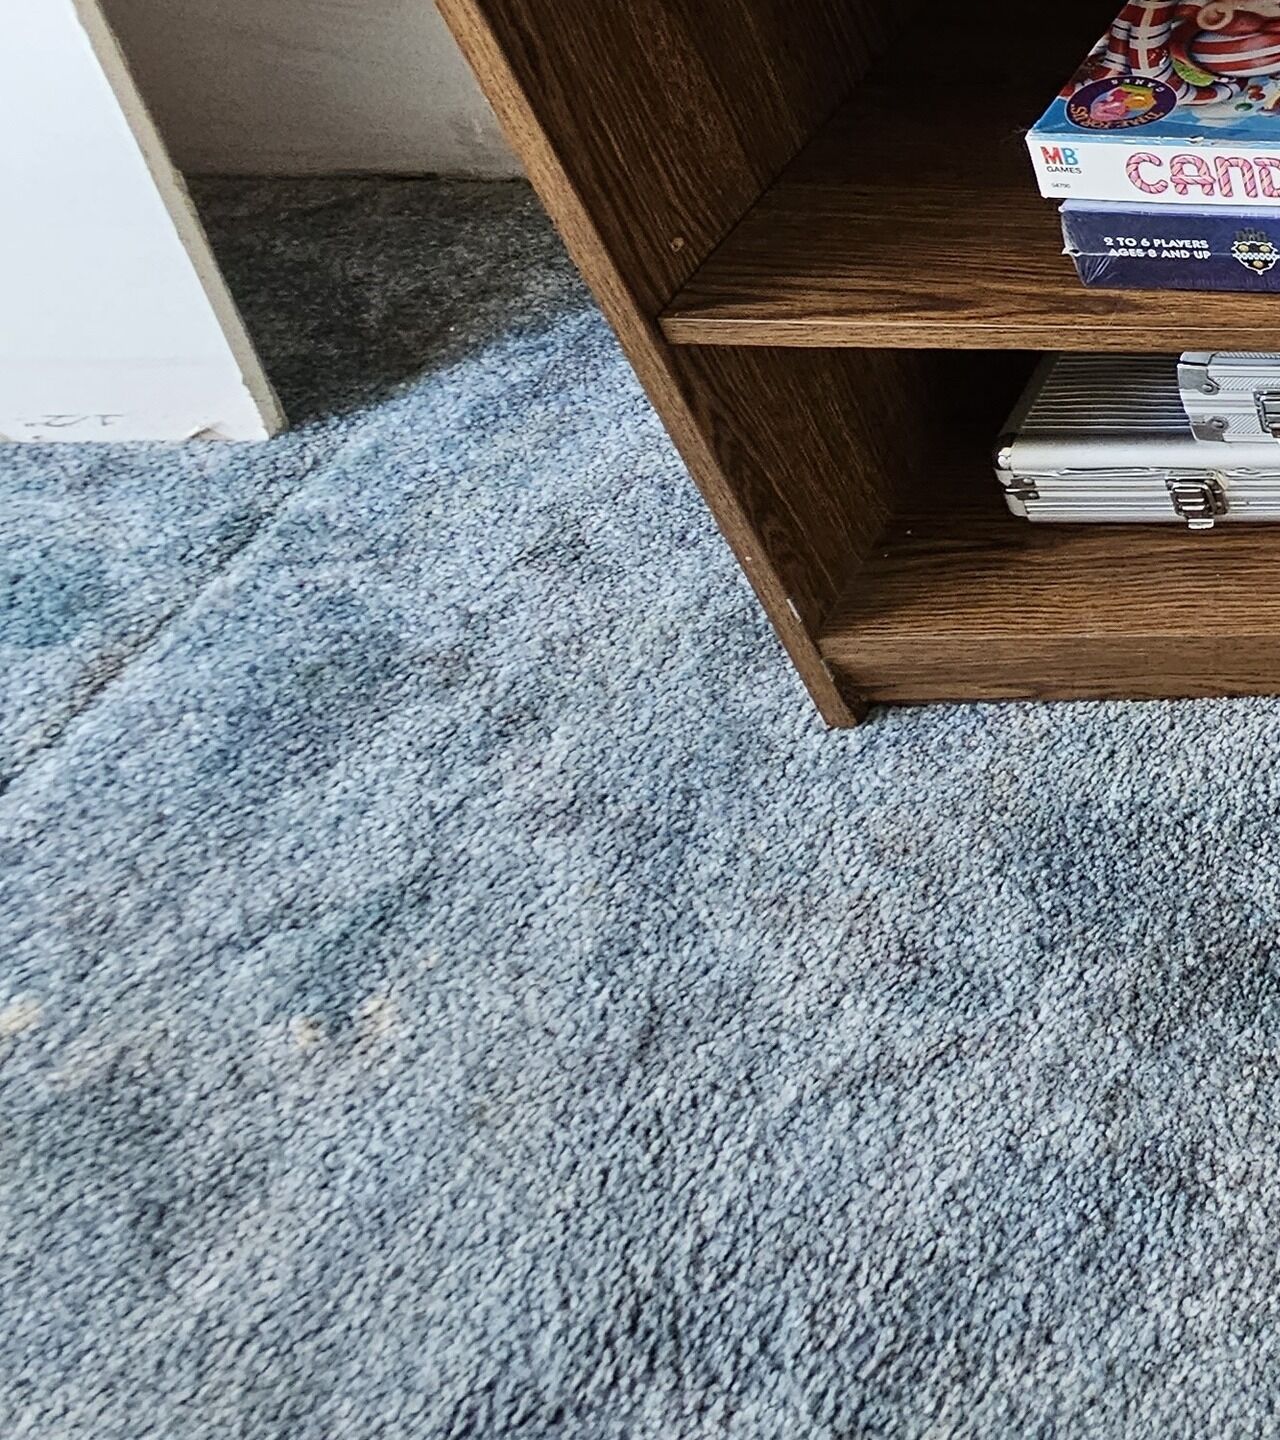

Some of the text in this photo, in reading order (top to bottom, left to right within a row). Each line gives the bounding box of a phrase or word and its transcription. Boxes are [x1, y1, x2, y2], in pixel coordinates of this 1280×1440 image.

[1040, 146, 1079, 166] MB
[1046, 166, 1082, 175] GAMES
[1104, 236, 1210, 250] 2 TO 6 PLAYERS
[1109, 247, 1145, 258] AGES
[1160, 249, 1190, 259] AND
[1194, 250, 1212, 260] UP
